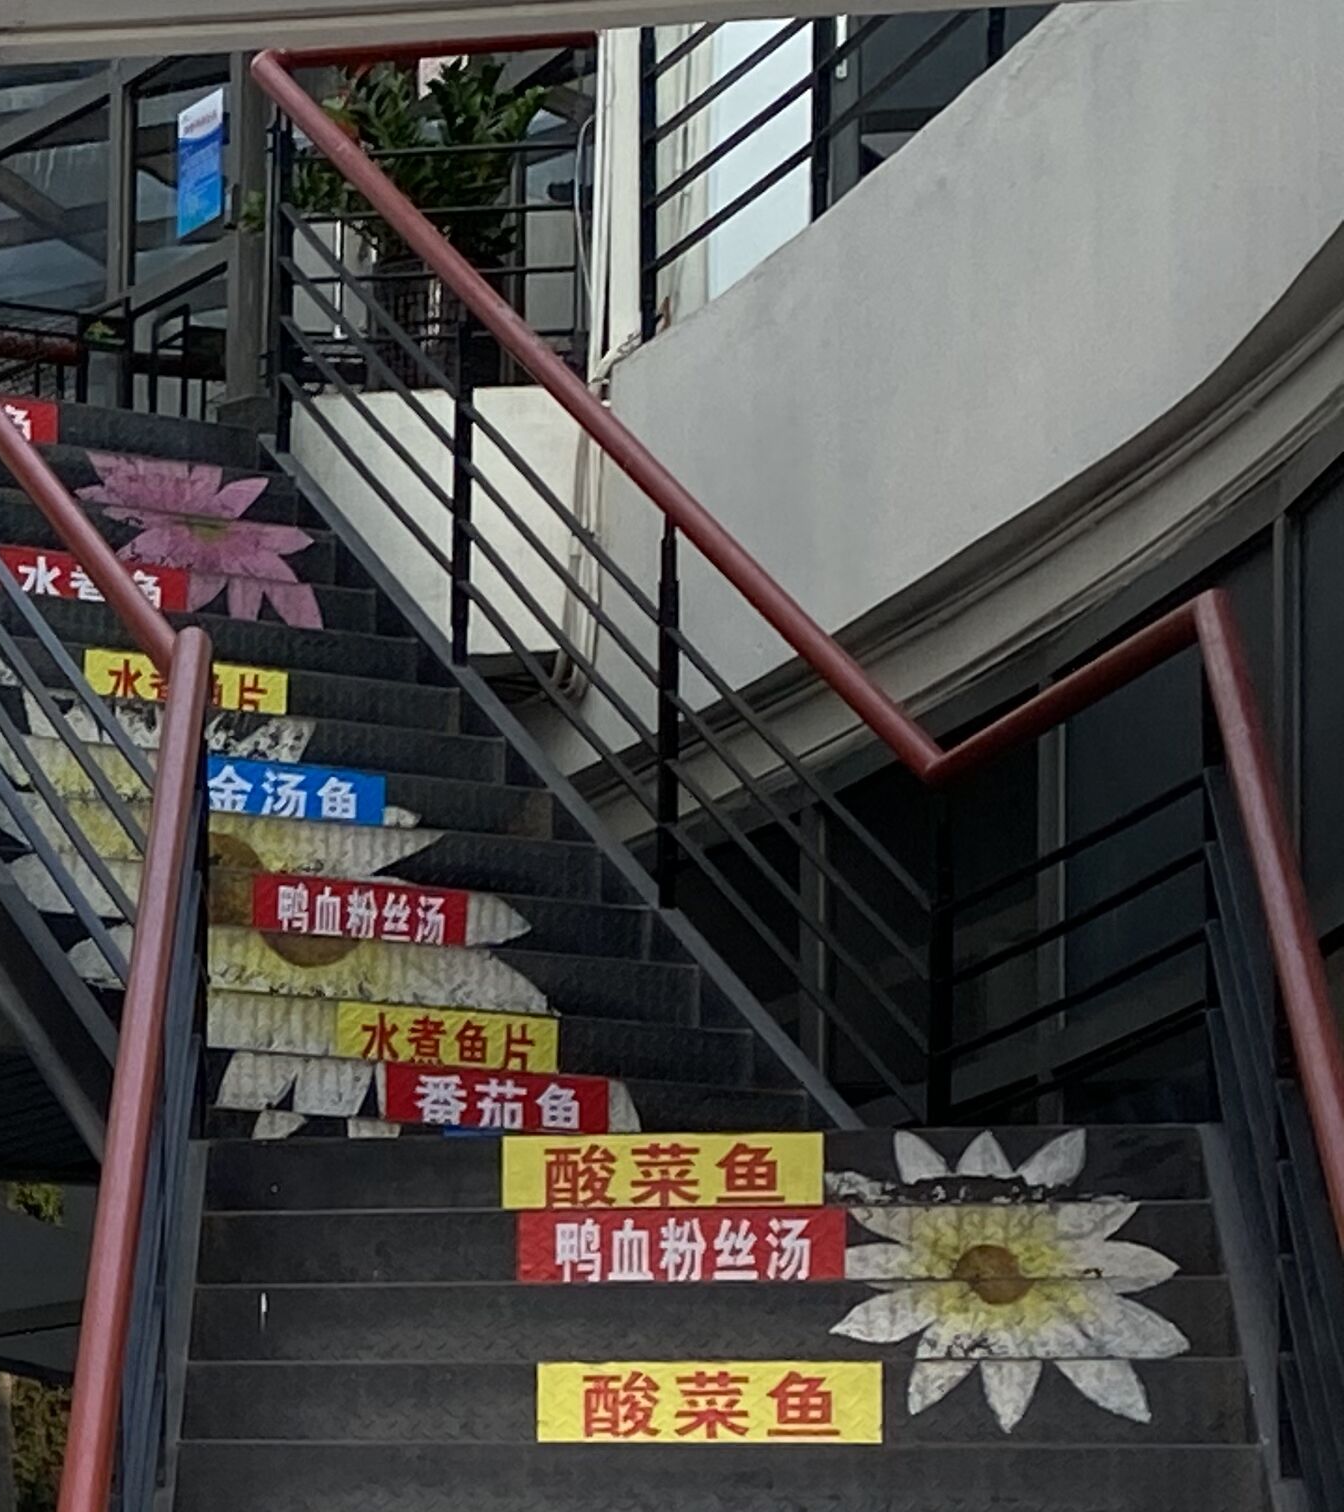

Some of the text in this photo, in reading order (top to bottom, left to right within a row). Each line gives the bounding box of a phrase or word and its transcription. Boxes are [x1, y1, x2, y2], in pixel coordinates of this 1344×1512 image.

[207, 764, 357, 820] 金汤鱼
[277, 883, 445, 945] 鸭血粉丝汤
[362, 1012, 535, 1072] 水煮鱼片
[415, 1075, 580, 1130] 番茄鱼
[543, 1143, 786, 1208] 酸菜鱼
[554, 1217, 811, 1282] 鸭血粉丝汤
[582, 1371, 841, 1440] 酸菜鱼
